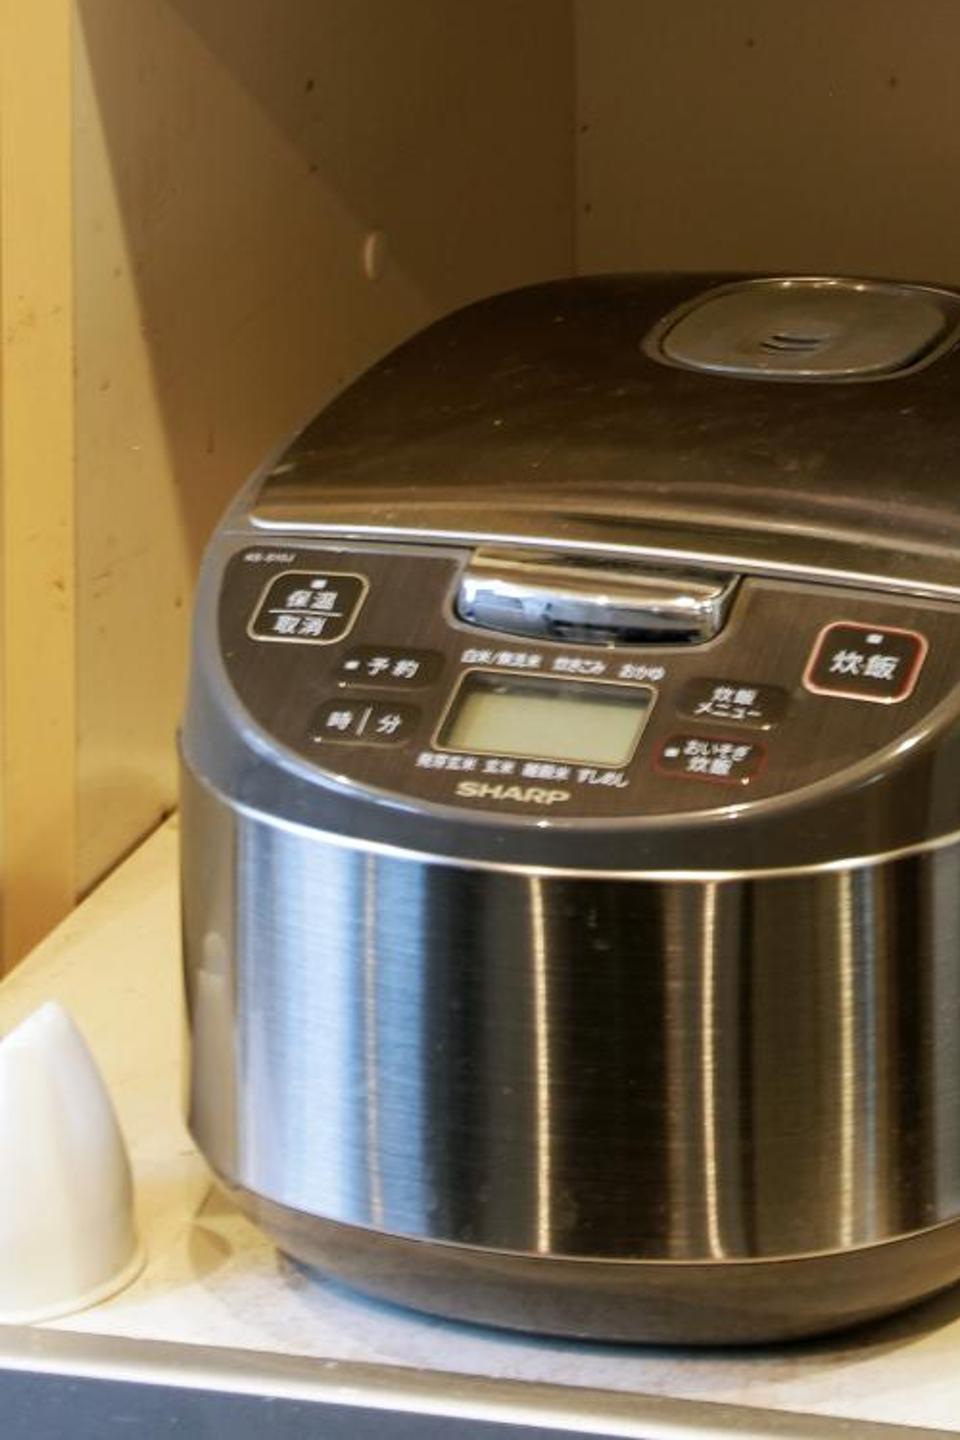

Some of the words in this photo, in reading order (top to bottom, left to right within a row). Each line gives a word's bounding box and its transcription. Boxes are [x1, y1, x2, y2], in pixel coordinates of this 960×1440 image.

[367, 658, 420, 678] 予約
[829, 650, 900, 680] 炊飯
[326, 712, 353, 730] 時
[377, 714, 401, 734] 分
[456, 780, 571, 805] SHARP
